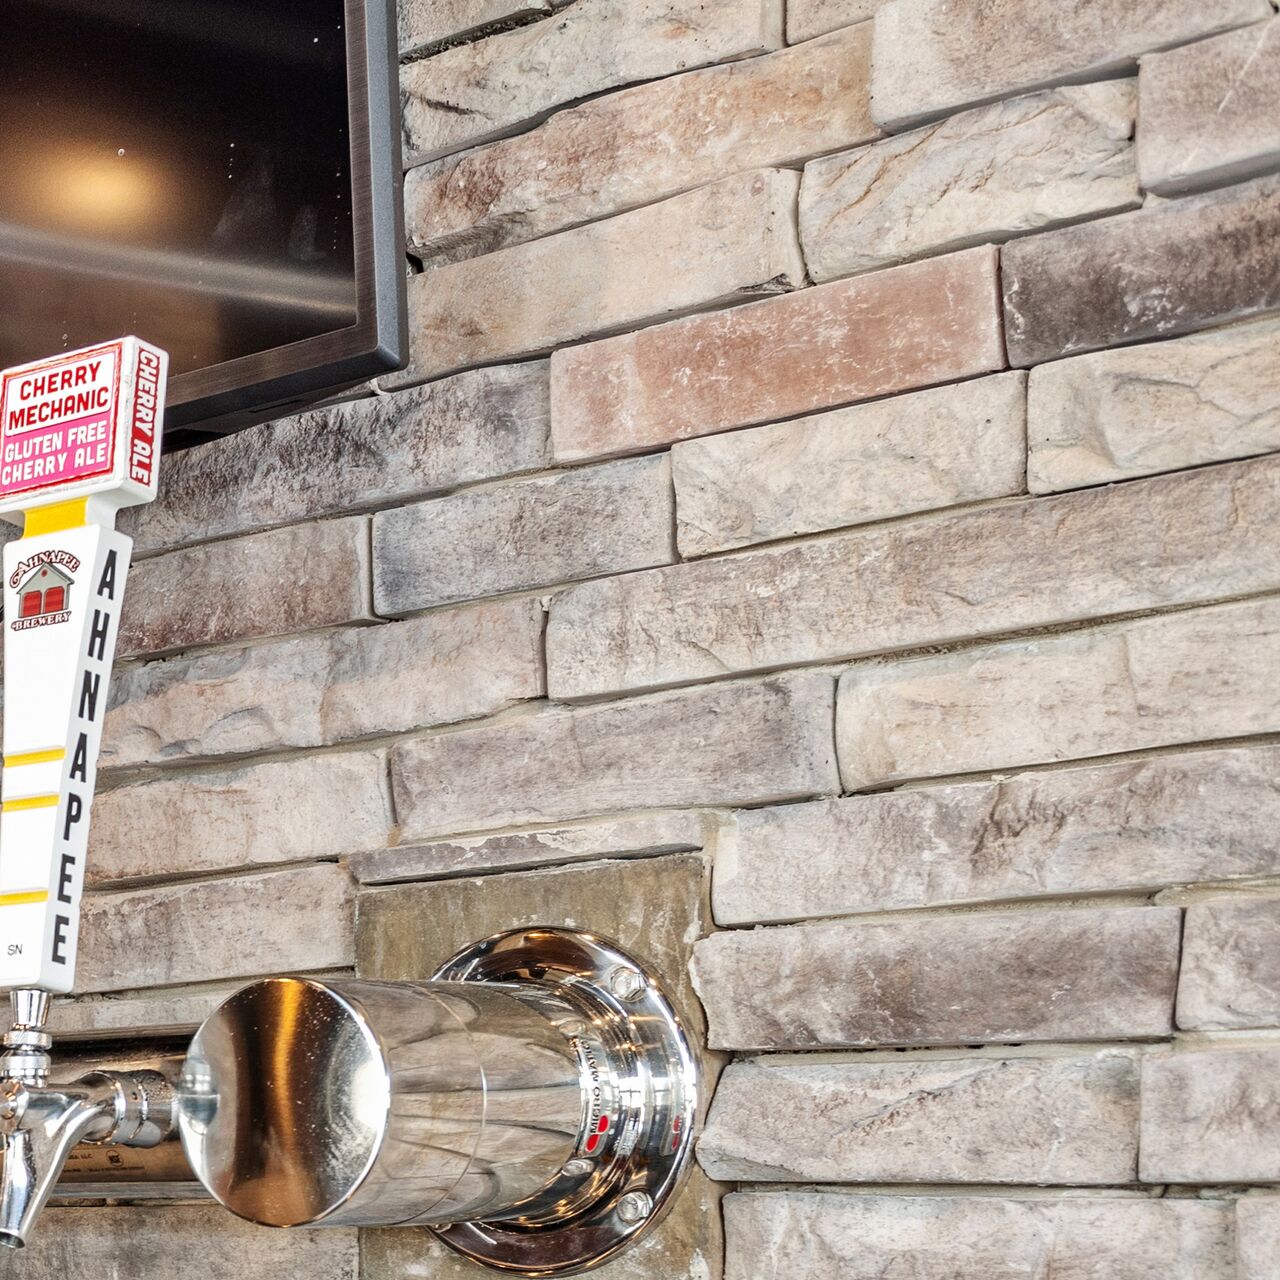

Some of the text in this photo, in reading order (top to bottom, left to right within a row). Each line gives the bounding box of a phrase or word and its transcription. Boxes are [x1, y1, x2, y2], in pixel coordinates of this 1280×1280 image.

[20, 361, 101, 401] CHERRY
[8, 386, 109, 431] MECHANIC
[130, 350, 160, 486] CHERRY ALE
[5, 420, 107, 463] GLUTEN FREE
[2, 443, 107, 486] CHERRY ALE
[9, 549, 81, 589] AHNAPEE
[11, 611, 72, 632] BREWERY
[51, 549, 118, 966] AHNAPEE
